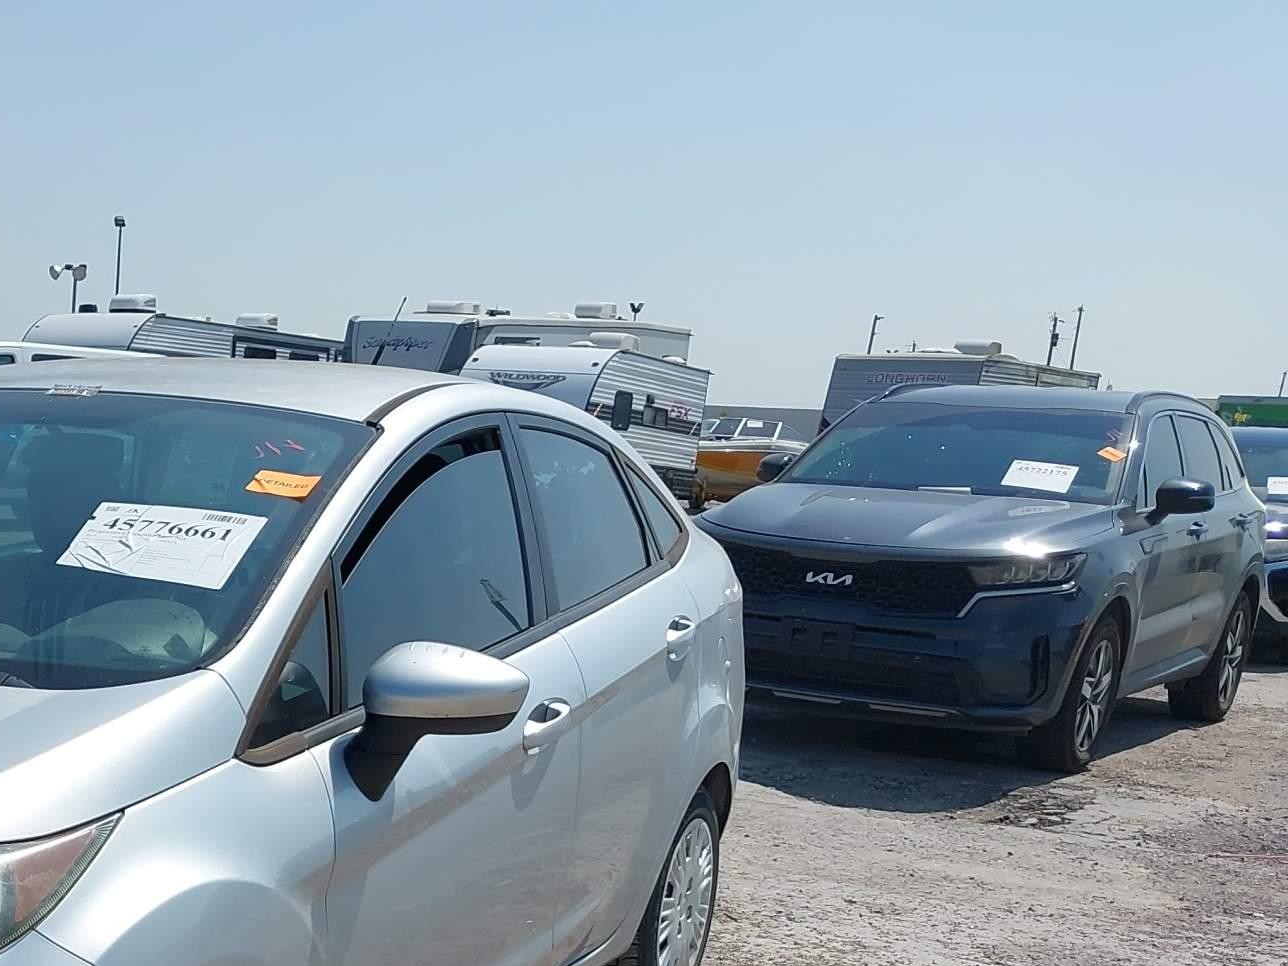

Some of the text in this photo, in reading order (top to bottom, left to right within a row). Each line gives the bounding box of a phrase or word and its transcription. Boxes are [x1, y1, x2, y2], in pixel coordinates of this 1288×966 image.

[489, 371, 566, 381] WILDWOOD
[865, 372, 947, 384] LONGHORN
[102, 517, 233, 542] 45776661
